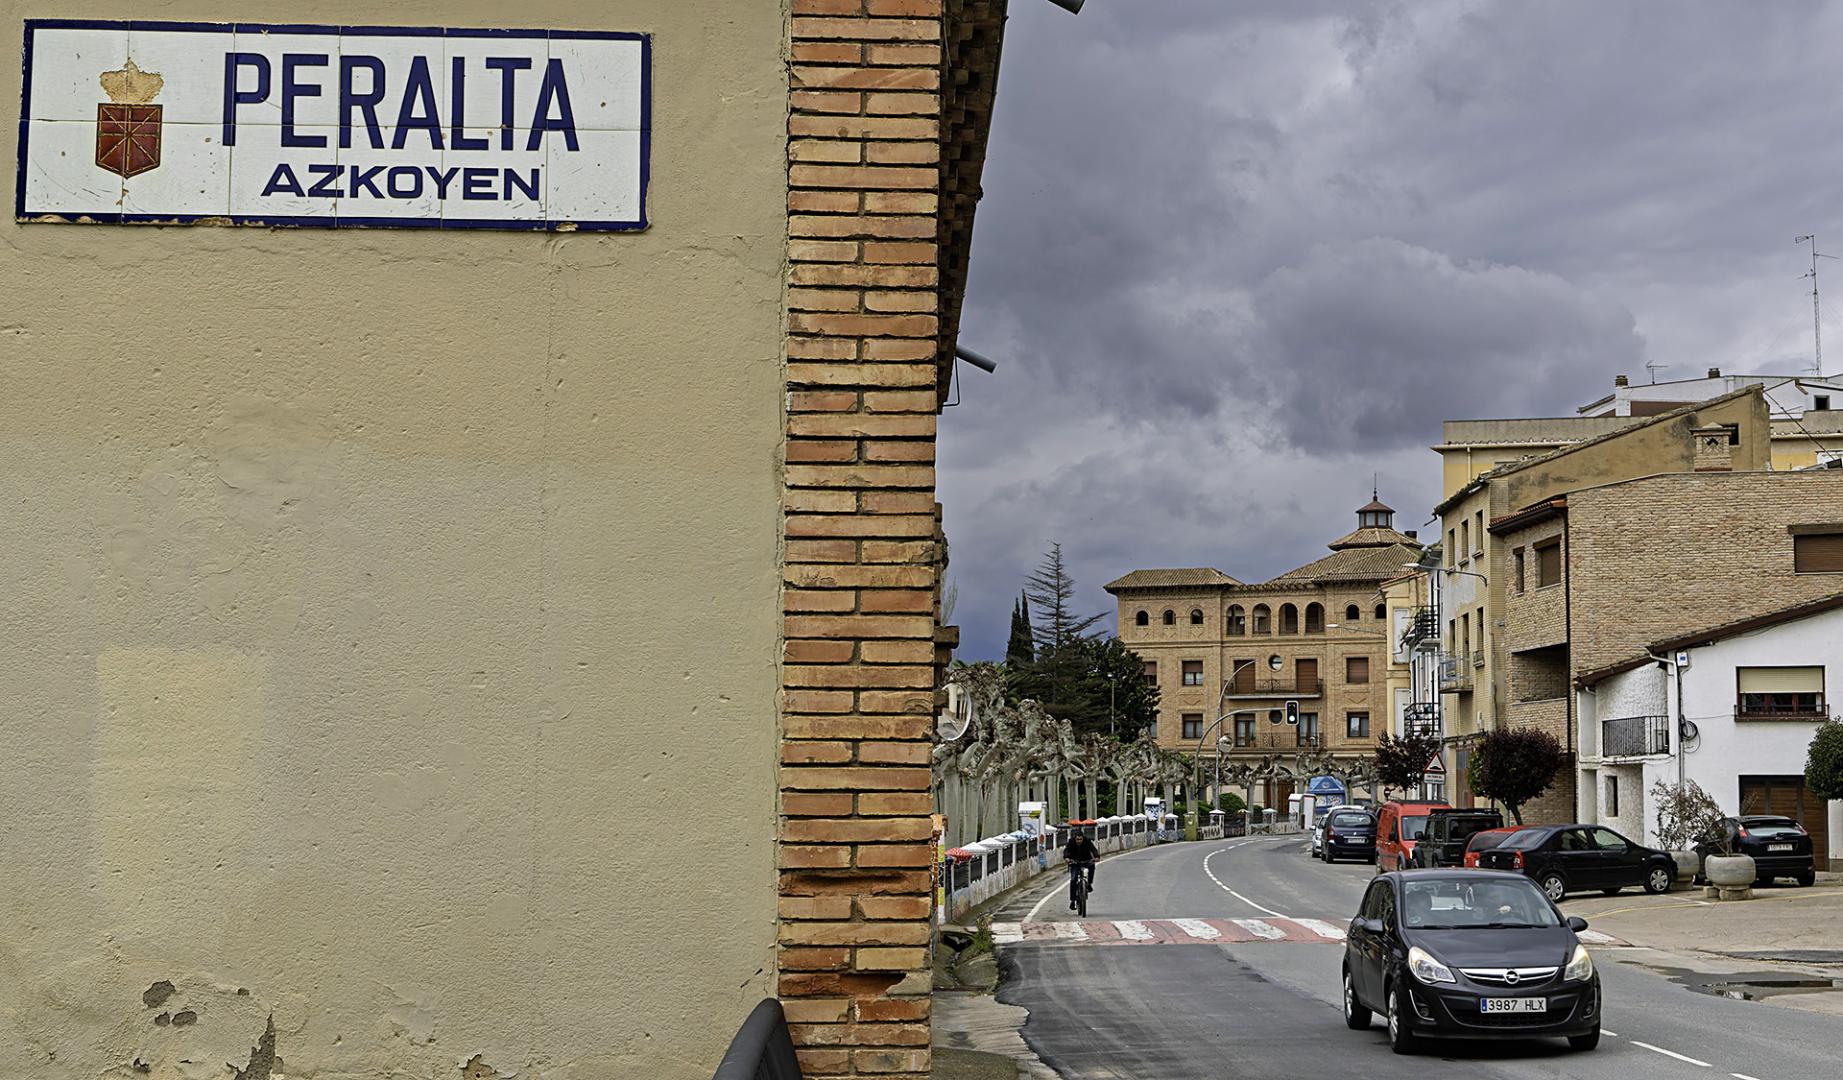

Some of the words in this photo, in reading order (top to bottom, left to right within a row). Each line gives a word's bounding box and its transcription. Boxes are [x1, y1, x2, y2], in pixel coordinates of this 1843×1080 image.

[223, 52, 580, 152] PERALTA
[261, 163, 541, 201] AZKOYEN
[1488, 999, 1518, 1011] 3987
[1524, 999, 1544, 1011] HLX
